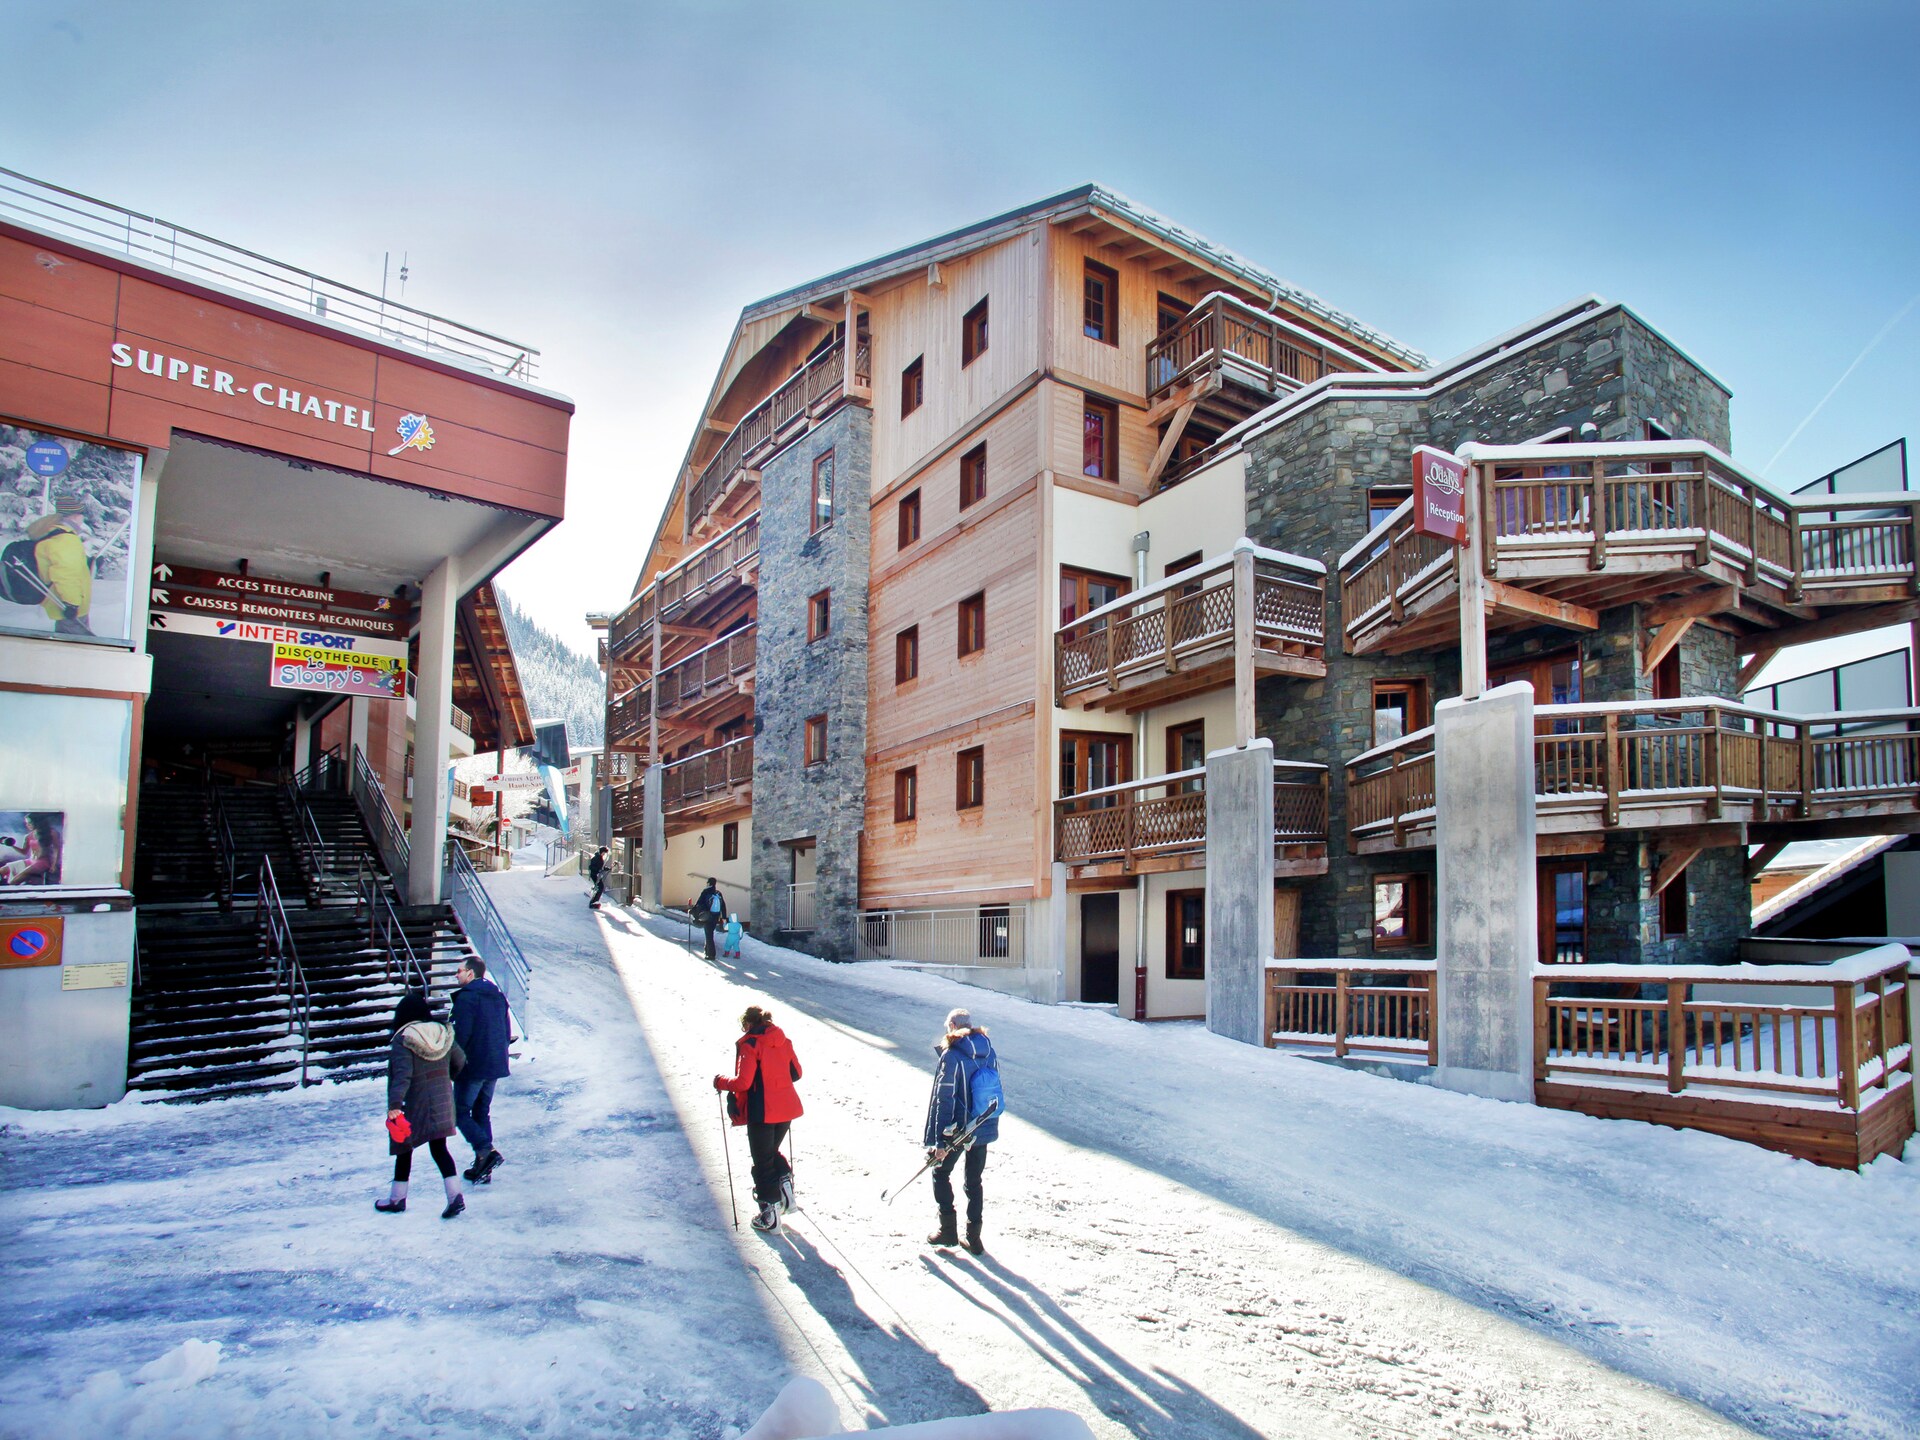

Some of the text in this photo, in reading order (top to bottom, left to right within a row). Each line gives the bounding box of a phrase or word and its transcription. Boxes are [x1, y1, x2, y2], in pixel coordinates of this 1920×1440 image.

[111, 343, 375, 432] SUPER-CHATEL
[1429, 502, 1464, 524] Réception
[217, 577, 335, 602] ACCES TELECABINE
[183, 595, 394, 632] CAISSES REMONTEES MECANIQUES
[277, 646, 379, 666] DISCOTHEQUE
[308, 657, 325, 669] Le
[281, 665, 364, 689] Sloopy's
